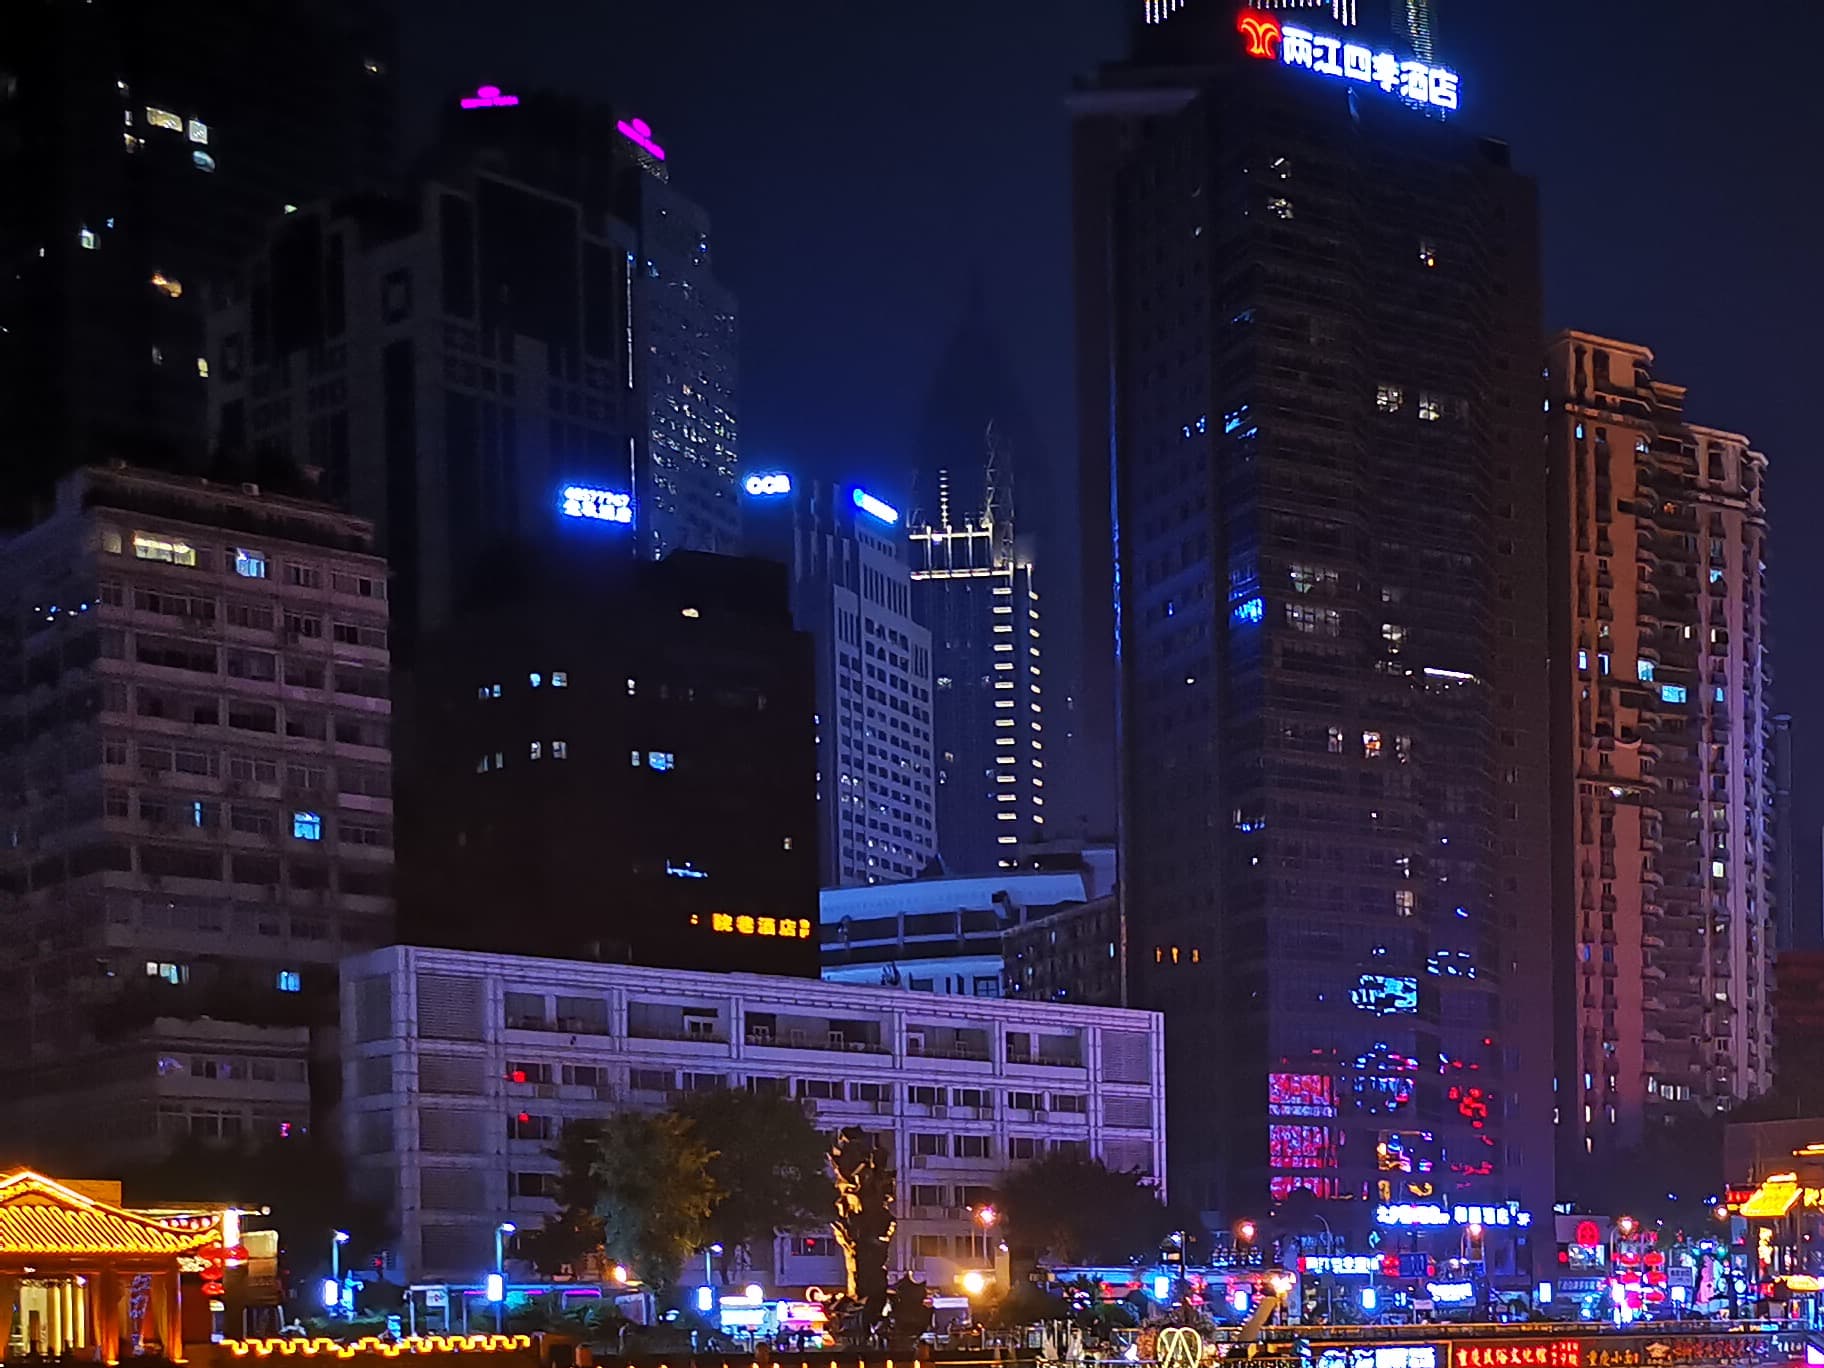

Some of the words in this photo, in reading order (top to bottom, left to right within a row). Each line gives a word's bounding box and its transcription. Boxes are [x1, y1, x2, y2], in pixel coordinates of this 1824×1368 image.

[1281, 26, 1458, 109] 两江四季酒店
